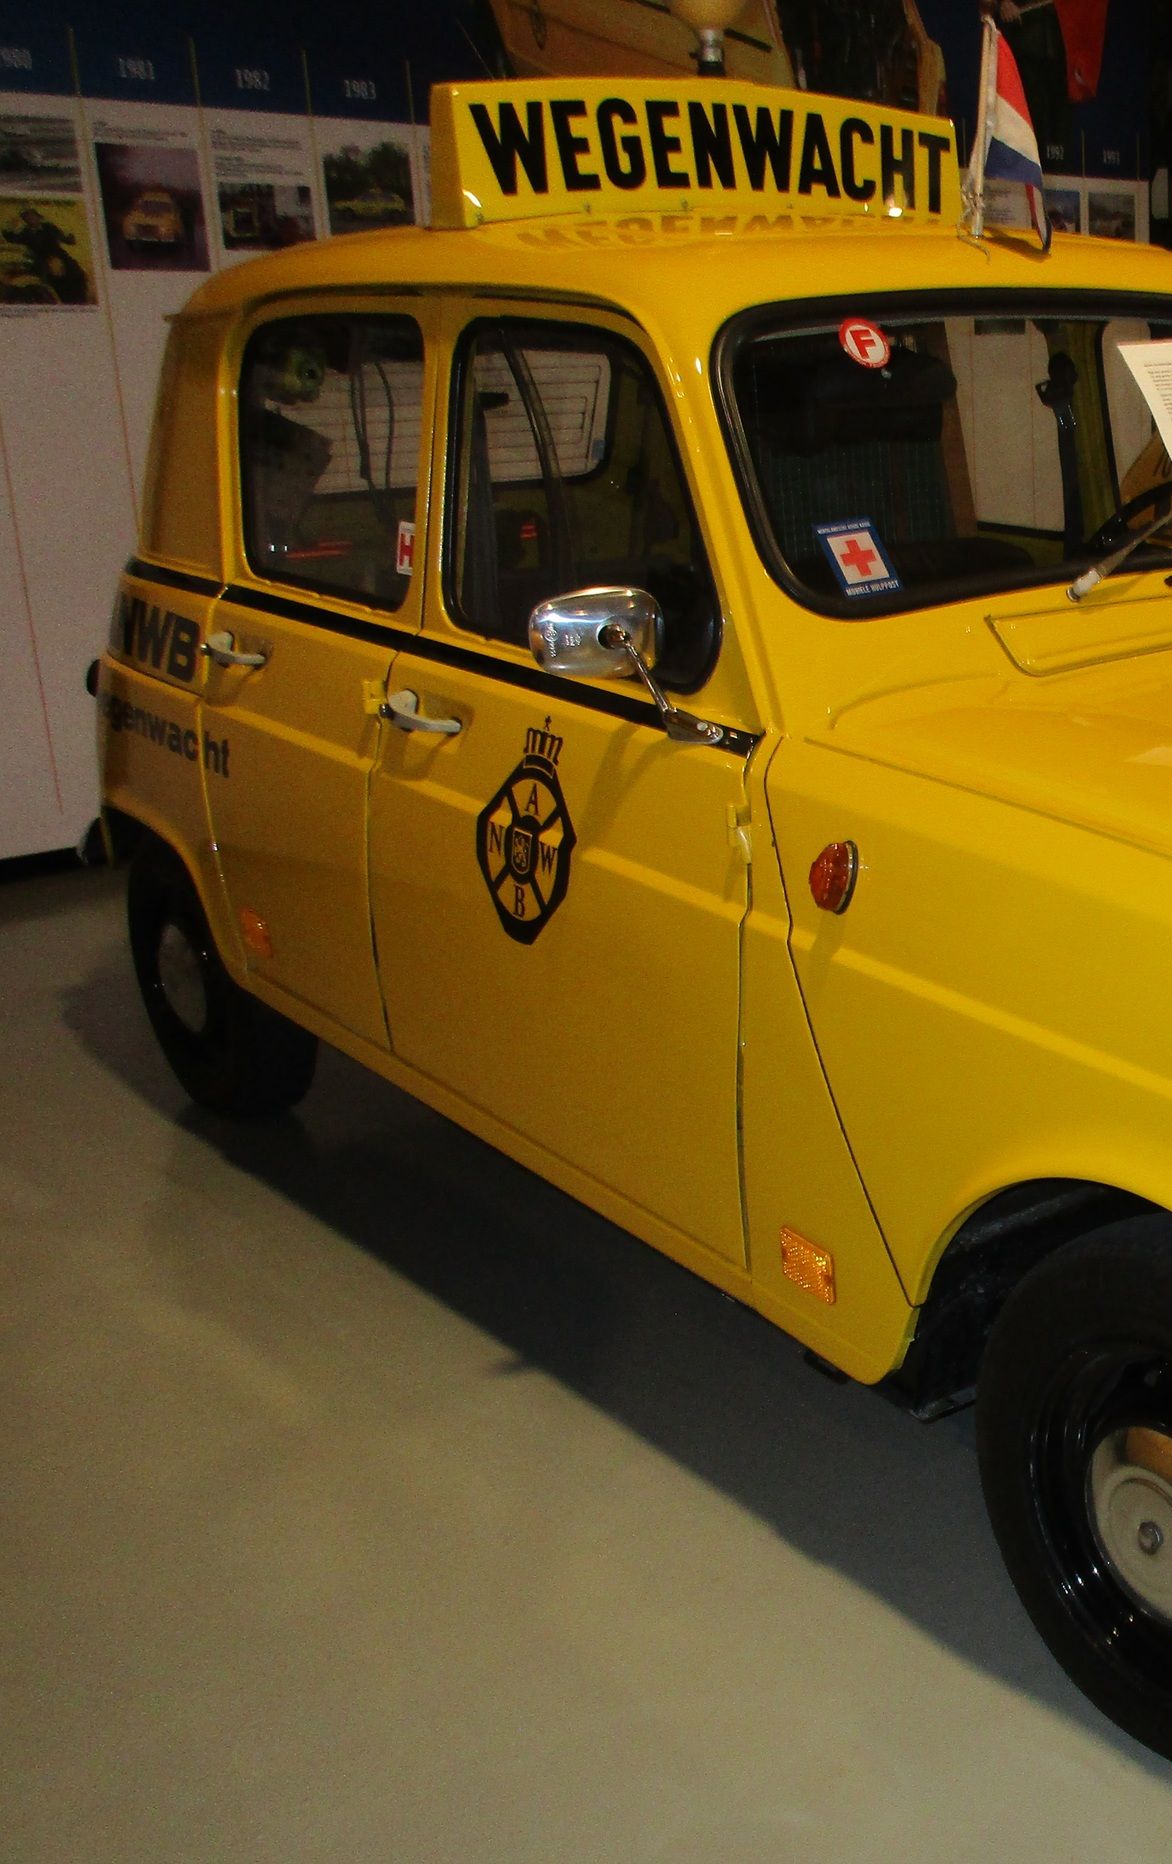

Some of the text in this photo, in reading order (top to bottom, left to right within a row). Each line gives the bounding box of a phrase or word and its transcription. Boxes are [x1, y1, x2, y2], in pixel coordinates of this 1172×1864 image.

[469, 97, 951, 214] WEGENWACHT
[849, 329, 877, 359] F
[524, 782, 540, 816] A
[488, 820, 505, 856] N
[538, 841, 558, 875] W
[513, 884, 526, 918] B
